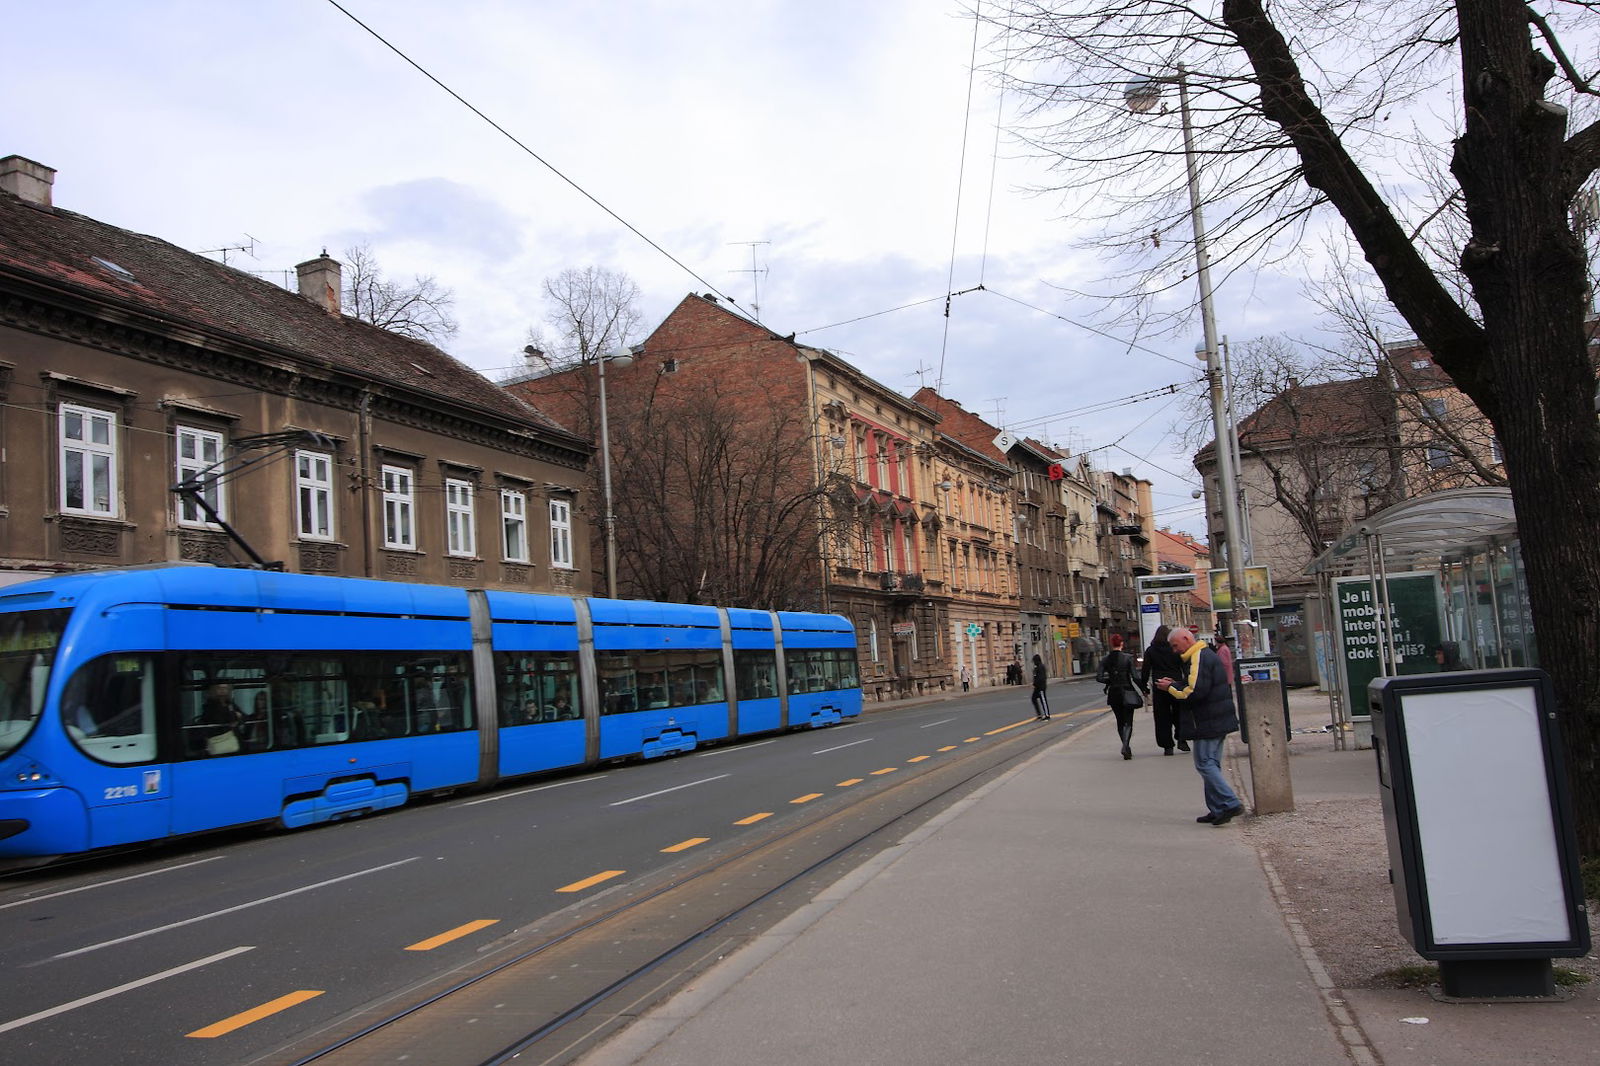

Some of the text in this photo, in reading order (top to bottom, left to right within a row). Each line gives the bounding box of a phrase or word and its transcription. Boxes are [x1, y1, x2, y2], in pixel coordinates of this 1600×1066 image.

[1000, 436, 1008, 446] S
[1342, 590, 1370, 603] Je li
[1346, 632, 1403, 645] mobln
[1348, 647, 1374, 659] dok
[104, 785, 137, 799] 2216
